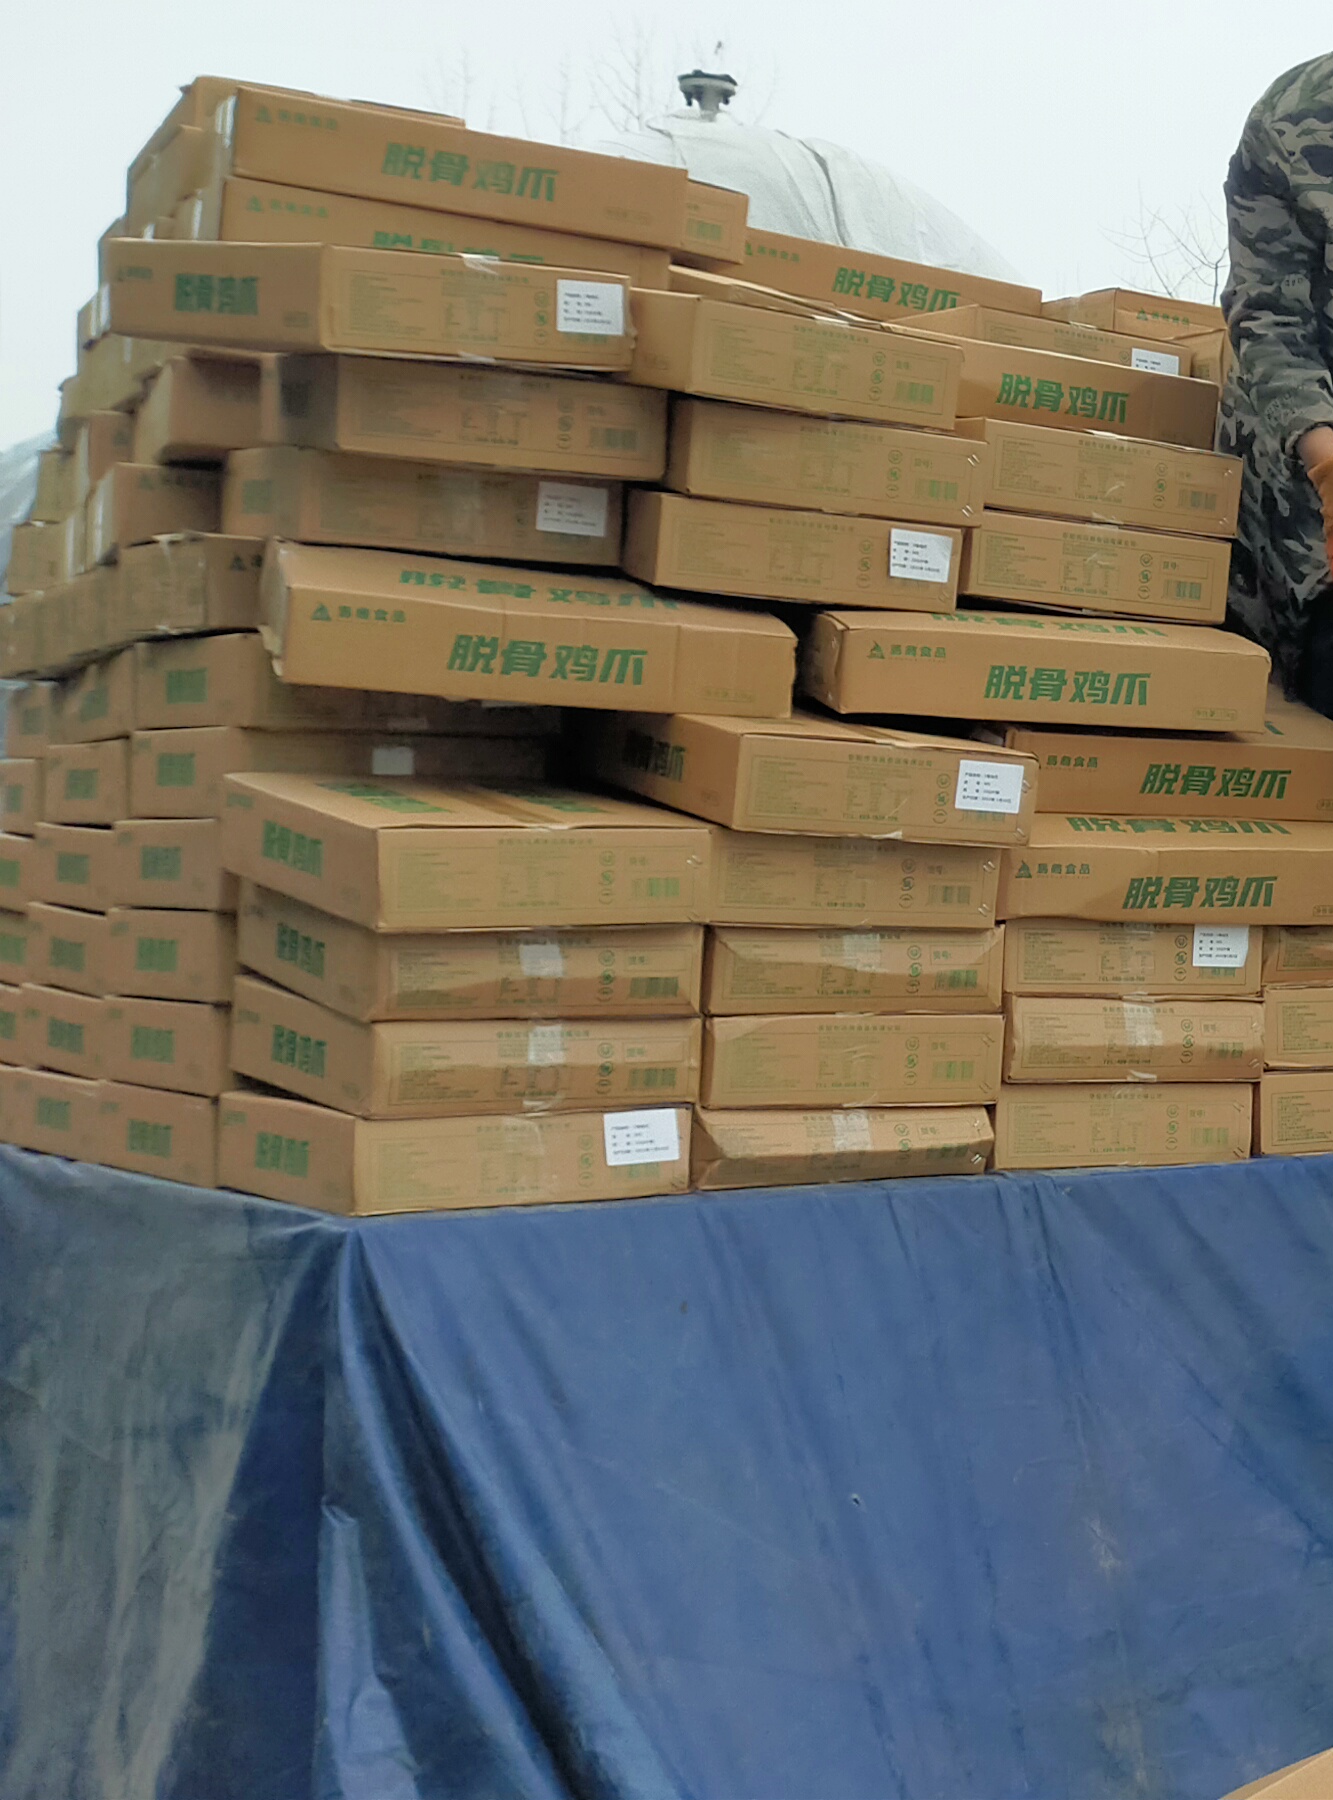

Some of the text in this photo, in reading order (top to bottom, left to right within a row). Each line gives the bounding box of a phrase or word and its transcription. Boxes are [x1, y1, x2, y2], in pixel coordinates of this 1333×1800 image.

[381, 142, 560, 202] 脱骨鸡爪
[996, 373, 1130, 424] 脱骨鸡爪
[447, 634, 648, 686] 脱骨鸡爪
[984, 665, 1152, 706] 脱骨鸡爪
[1141, 764, 1292, 800] 脱骨鸡爪
[1123, 876, 1277, 909] 脱骨鸡爪
